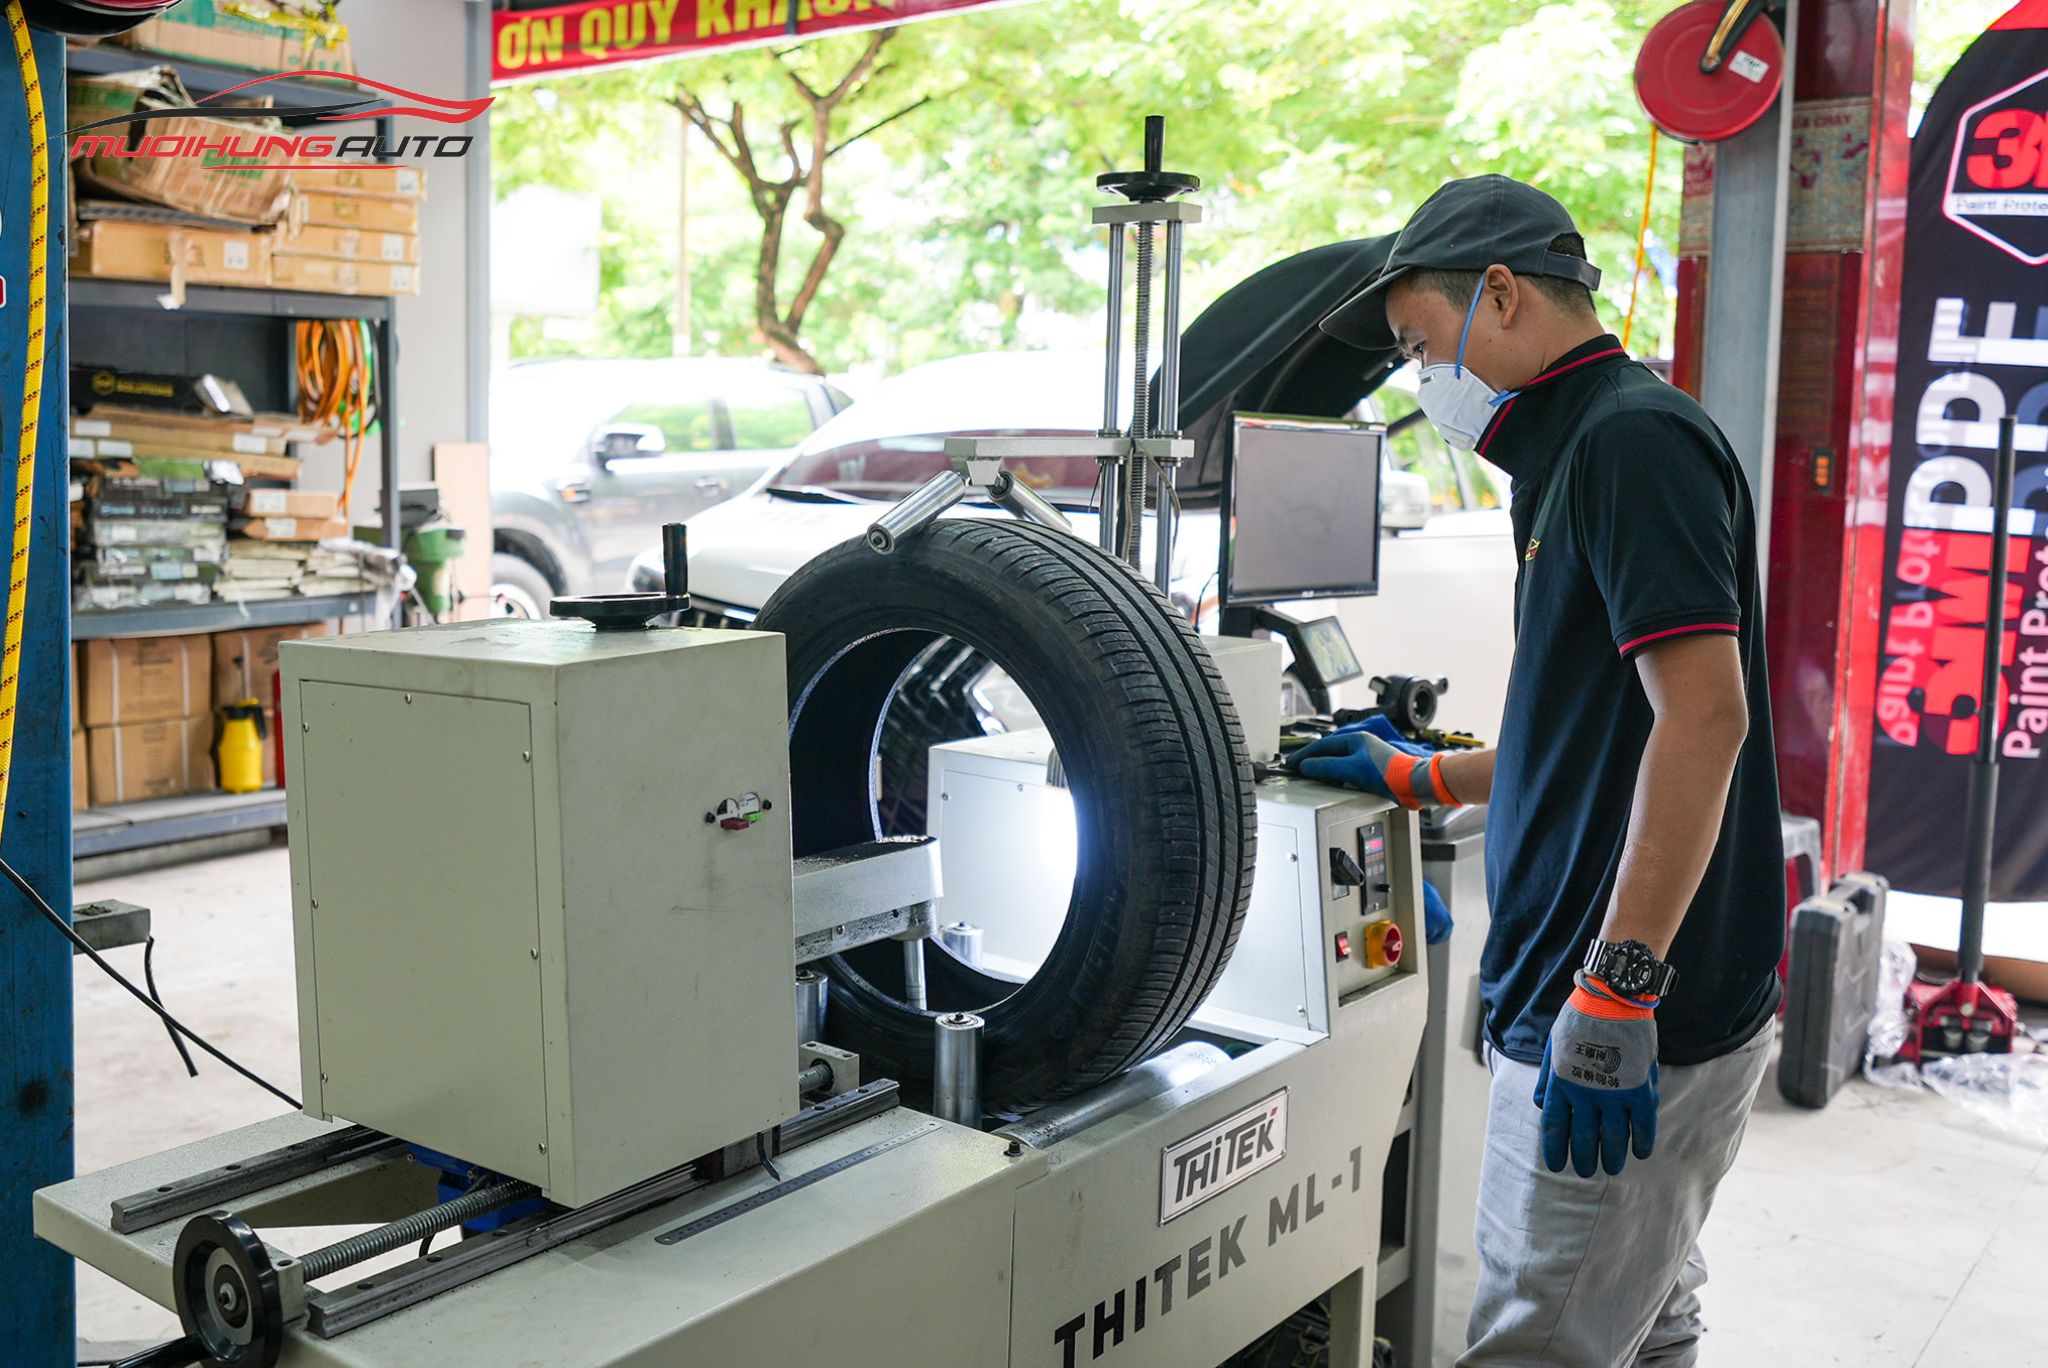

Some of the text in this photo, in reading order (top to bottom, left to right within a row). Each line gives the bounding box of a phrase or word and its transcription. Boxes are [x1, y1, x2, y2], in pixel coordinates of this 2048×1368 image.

[498, 15, 564, 69] ƠN
[1966, 108, 2048, 189] 3
[1054, 1145, 1361, 1368] THITEK ML-1
